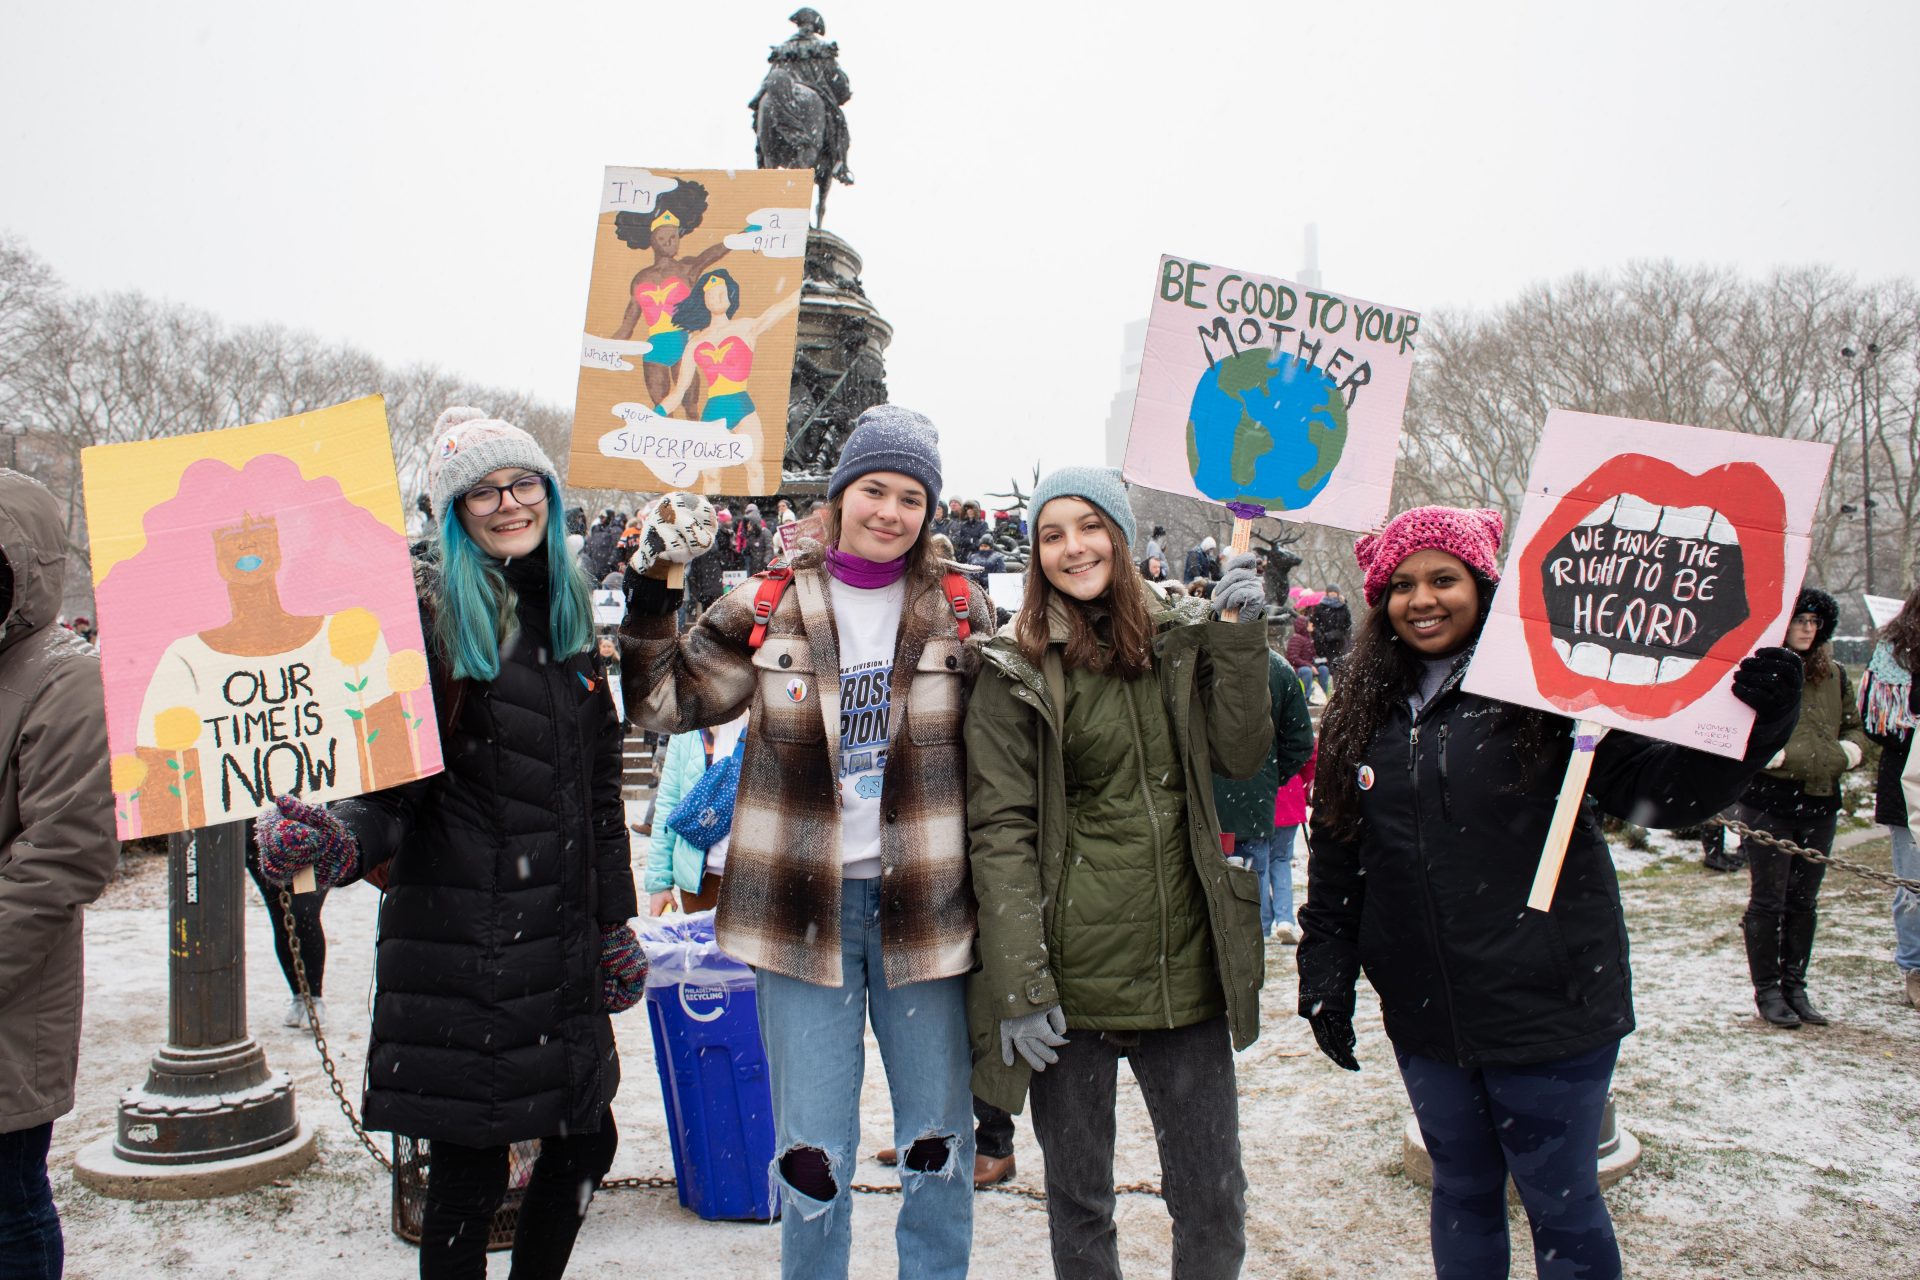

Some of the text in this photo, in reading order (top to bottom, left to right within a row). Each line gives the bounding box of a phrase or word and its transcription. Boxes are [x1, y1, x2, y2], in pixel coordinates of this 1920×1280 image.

[610, 180, 651, 206] I'm
[768, 214, 782, 230] a
[752, 233, 787, 254] girl
[1160, 260, 1420, 355] BE GOOD TO YOUR
[1197, 316, 1372, 411] MOTHER
[621, 408, 654, 423] your
[614, 432, 744, 460] SUPERPOWER
[672, 462, 687, 485] ?
[1570, 526, 1720, 568] WE HAVE THE
[1549, 553, 1719, 602] RIGHT TO BE
[1573, 593, 1698, 647] HEARD
[852, 660, 883, 673] DIVISION
[222, 663, 315, 707] OUR
[203, 701, 323, 748] TIME IS
[221, 737, 338, 812] NOW
[685, 993, 723, 1001] RECYCLING
